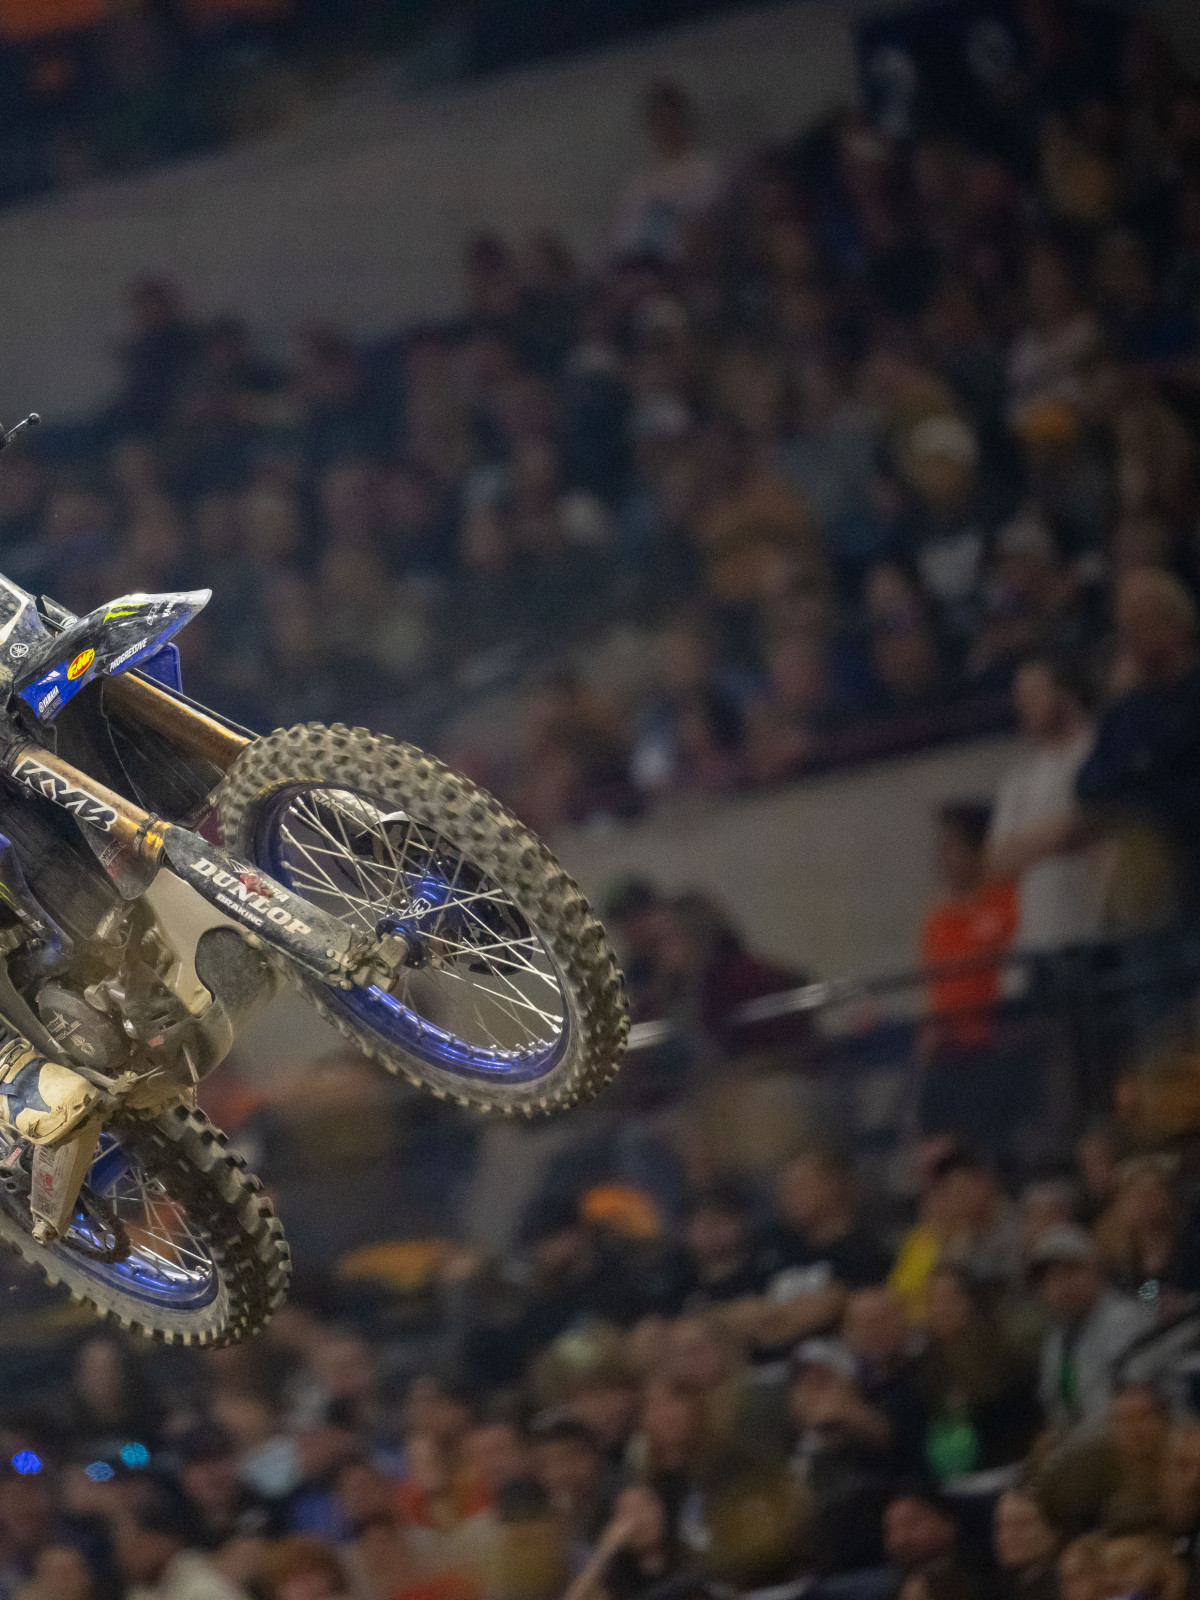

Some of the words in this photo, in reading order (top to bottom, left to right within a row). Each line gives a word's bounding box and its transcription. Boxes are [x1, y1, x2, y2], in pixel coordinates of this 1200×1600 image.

[68, 649, 94, 679] FMF
[109, 637, 148, 673] PROGRESSIVE
[11, 755, 119, 832] KYB
[189, 857, 313, 935] DUNLOP
[214, 892, 264, 928] BRAKING
